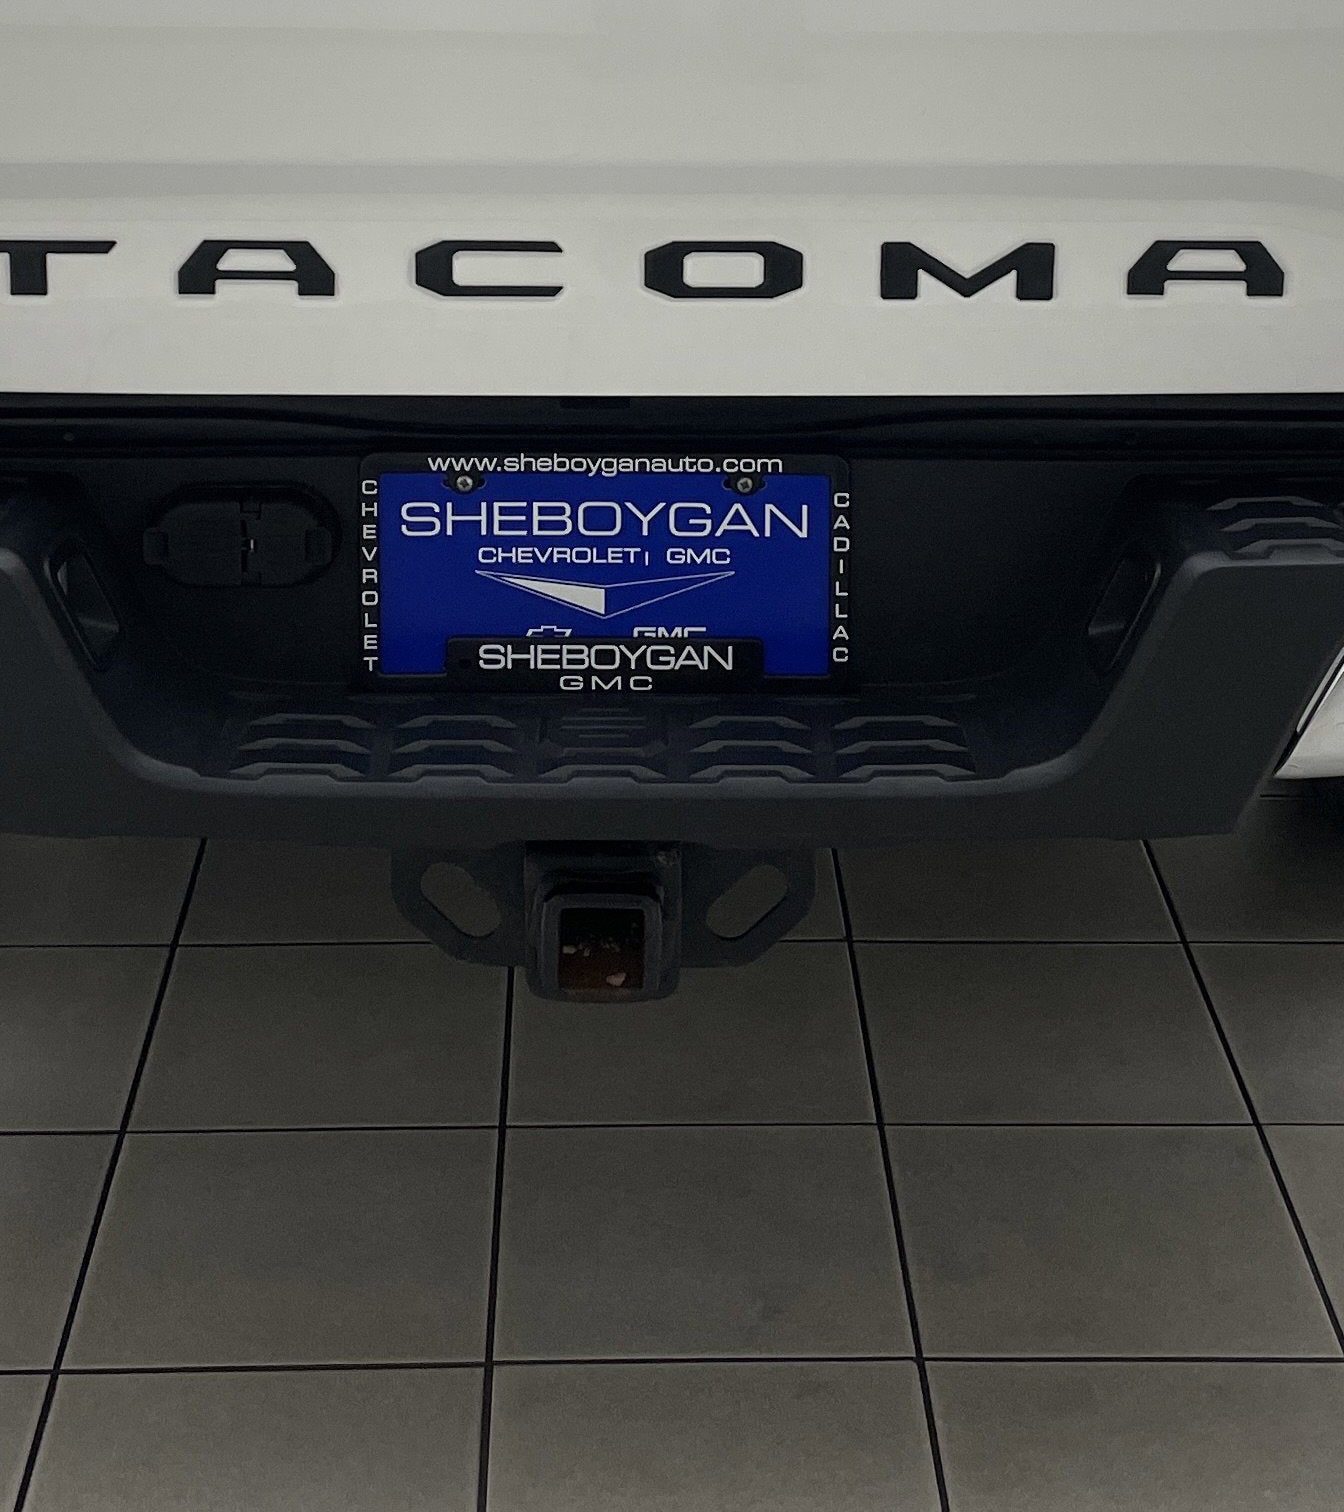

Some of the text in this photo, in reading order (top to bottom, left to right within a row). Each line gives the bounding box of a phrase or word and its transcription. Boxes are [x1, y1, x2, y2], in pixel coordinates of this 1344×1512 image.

[427, 452, 784, 477] www.sheboyganauto.com
[399, 501, 810, 539] SHEBOYGAN
[666, 548, 732, 565] GMC
[361, 479, 378, 672] CHEVROLET
[832, 492, 851, 664] CADILLAC
[478, 644, 734, 671] SHEBOYGAN
[559, 675, 654, 691] GMC
